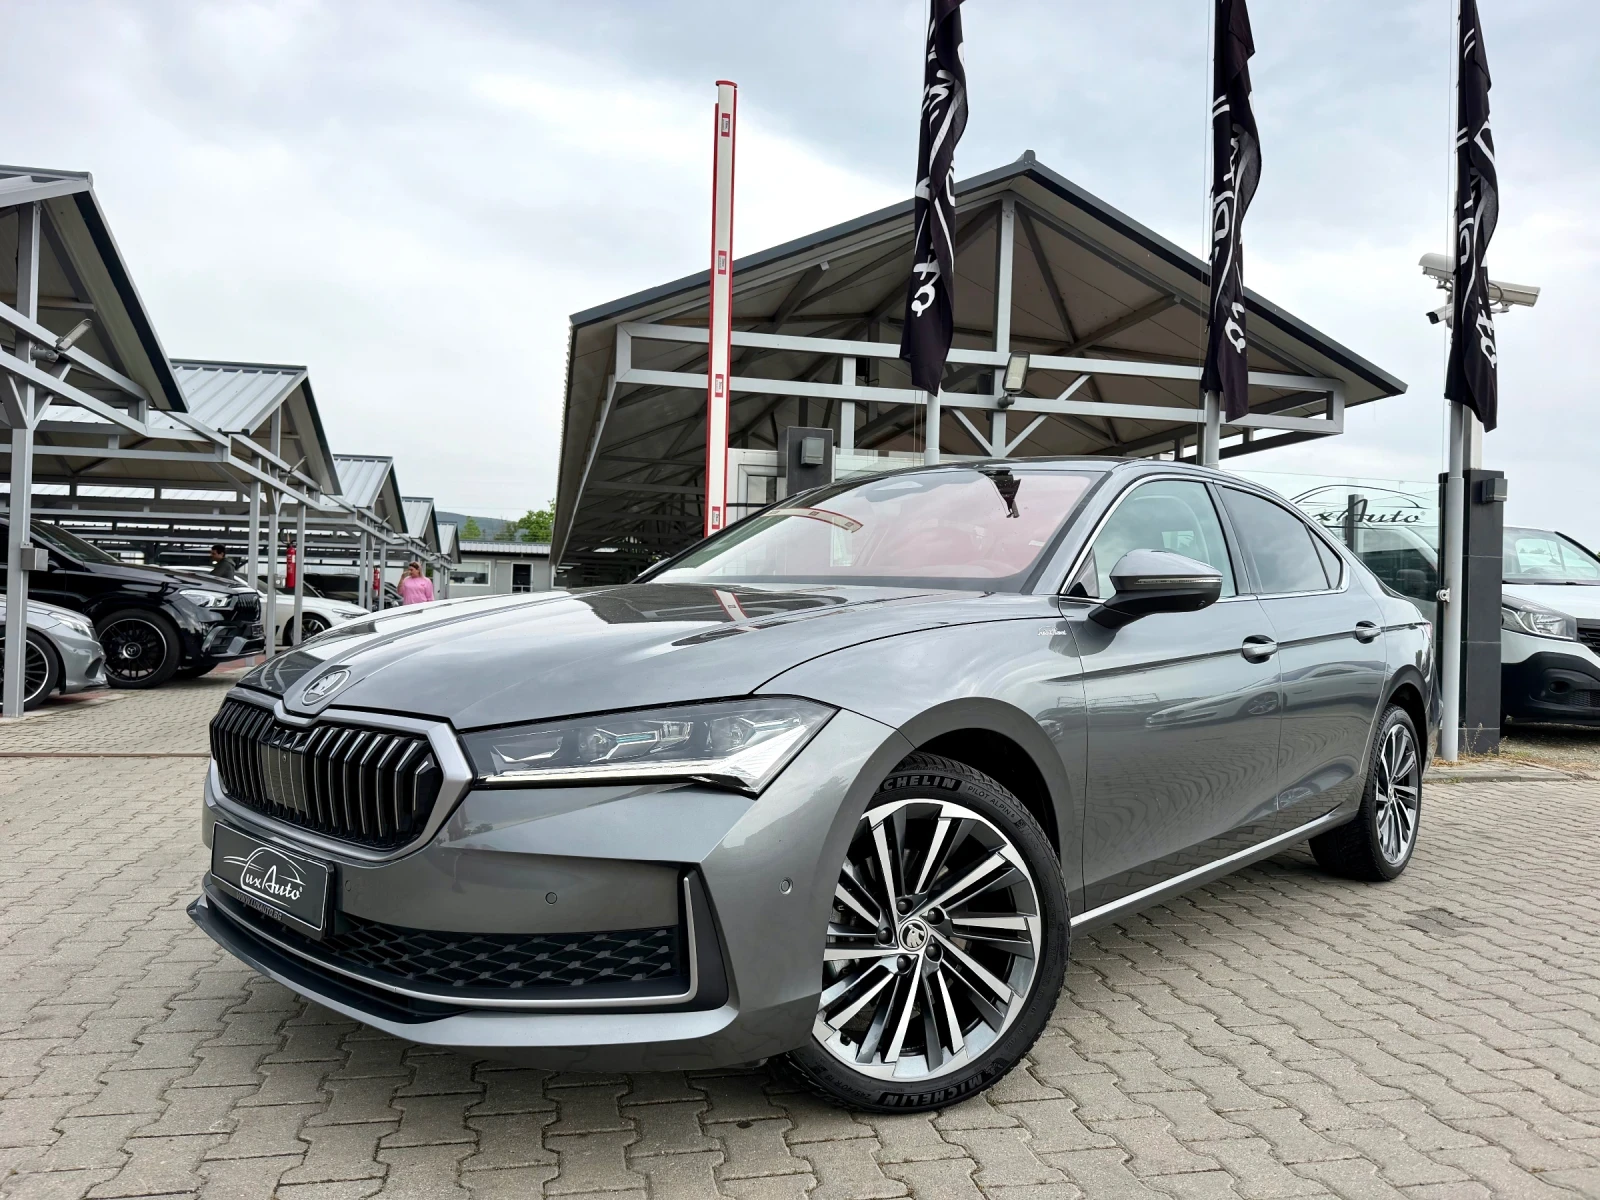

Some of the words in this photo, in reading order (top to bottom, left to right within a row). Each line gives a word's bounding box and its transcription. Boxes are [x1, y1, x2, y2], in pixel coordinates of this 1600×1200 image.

[877, 775, 956, 792] CHELIN
[967, 785, 991, 799] PILOT
[990, 798, 1012, 816] ALPIN
[884, 1074, 984, 1106] MICHELIN
